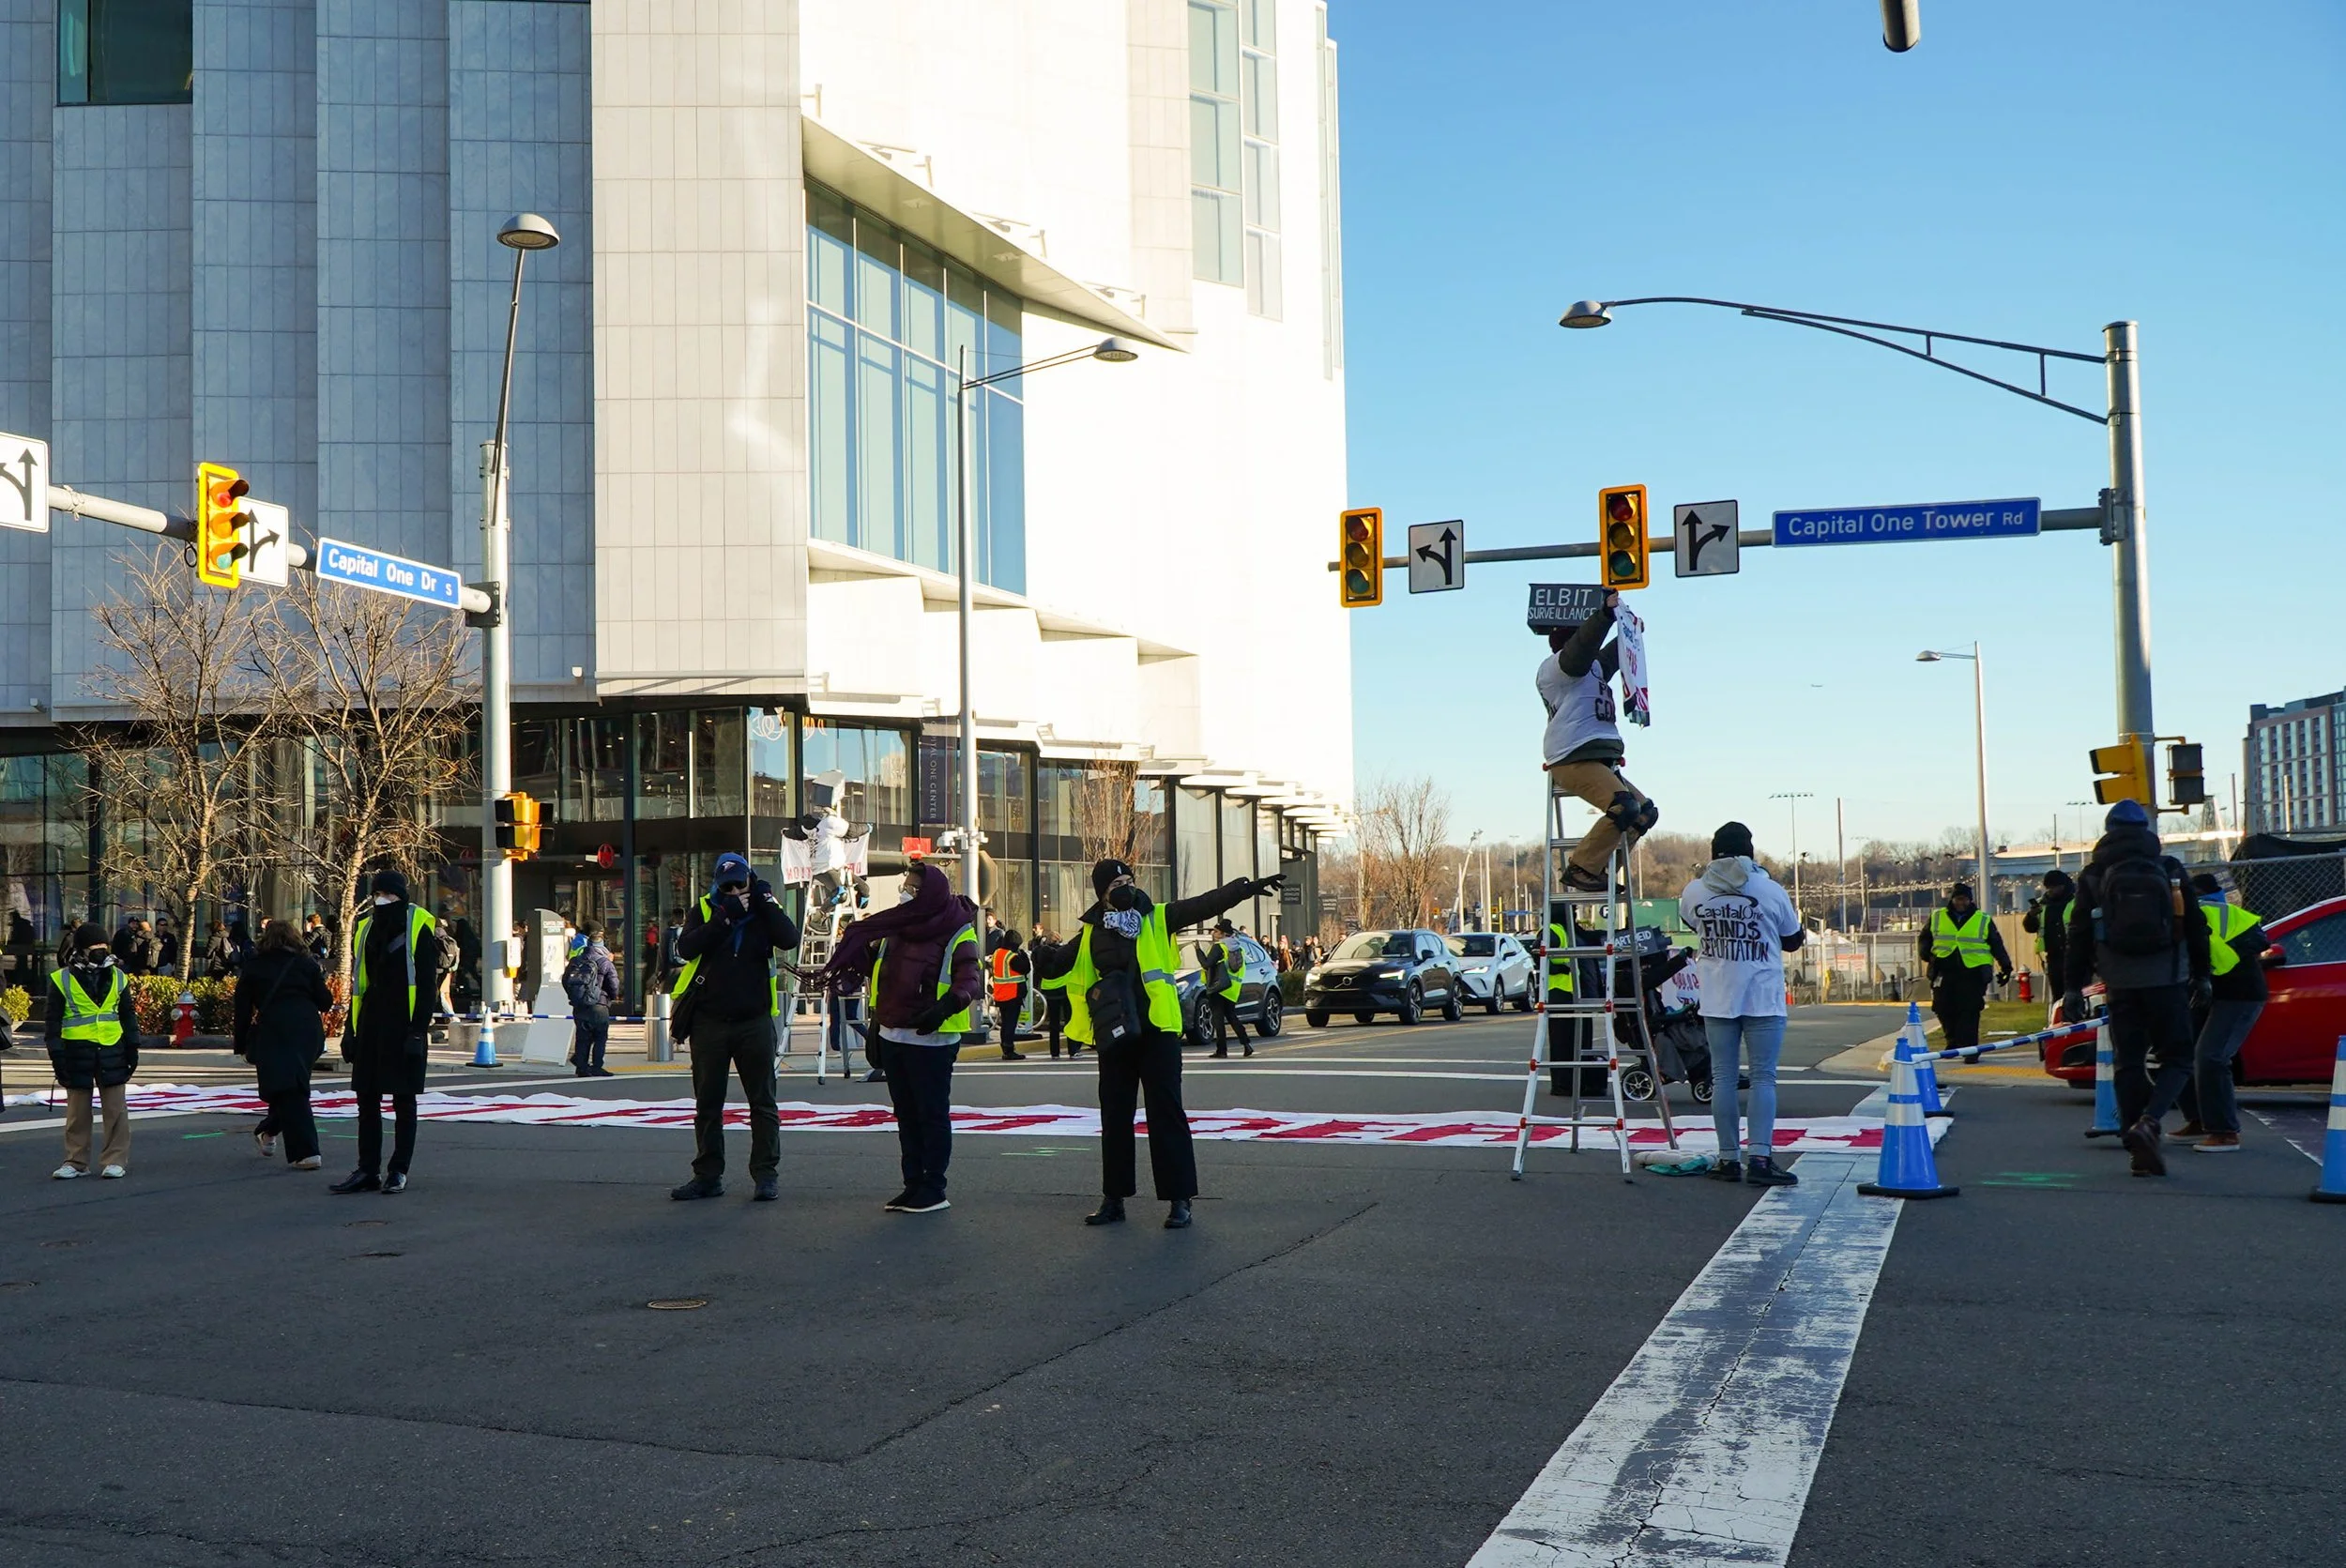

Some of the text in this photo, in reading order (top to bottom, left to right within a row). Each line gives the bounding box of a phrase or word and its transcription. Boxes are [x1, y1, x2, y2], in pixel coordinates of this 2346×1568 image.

[1789, 510, 2023, 539] Capital One Tower Rd
[328, 548, 378, 578] Capital
[386, 563, 414, 586] One
[420, 571, 437, 592] Dr
[1535, 587, 1592, 606] ELBIT
